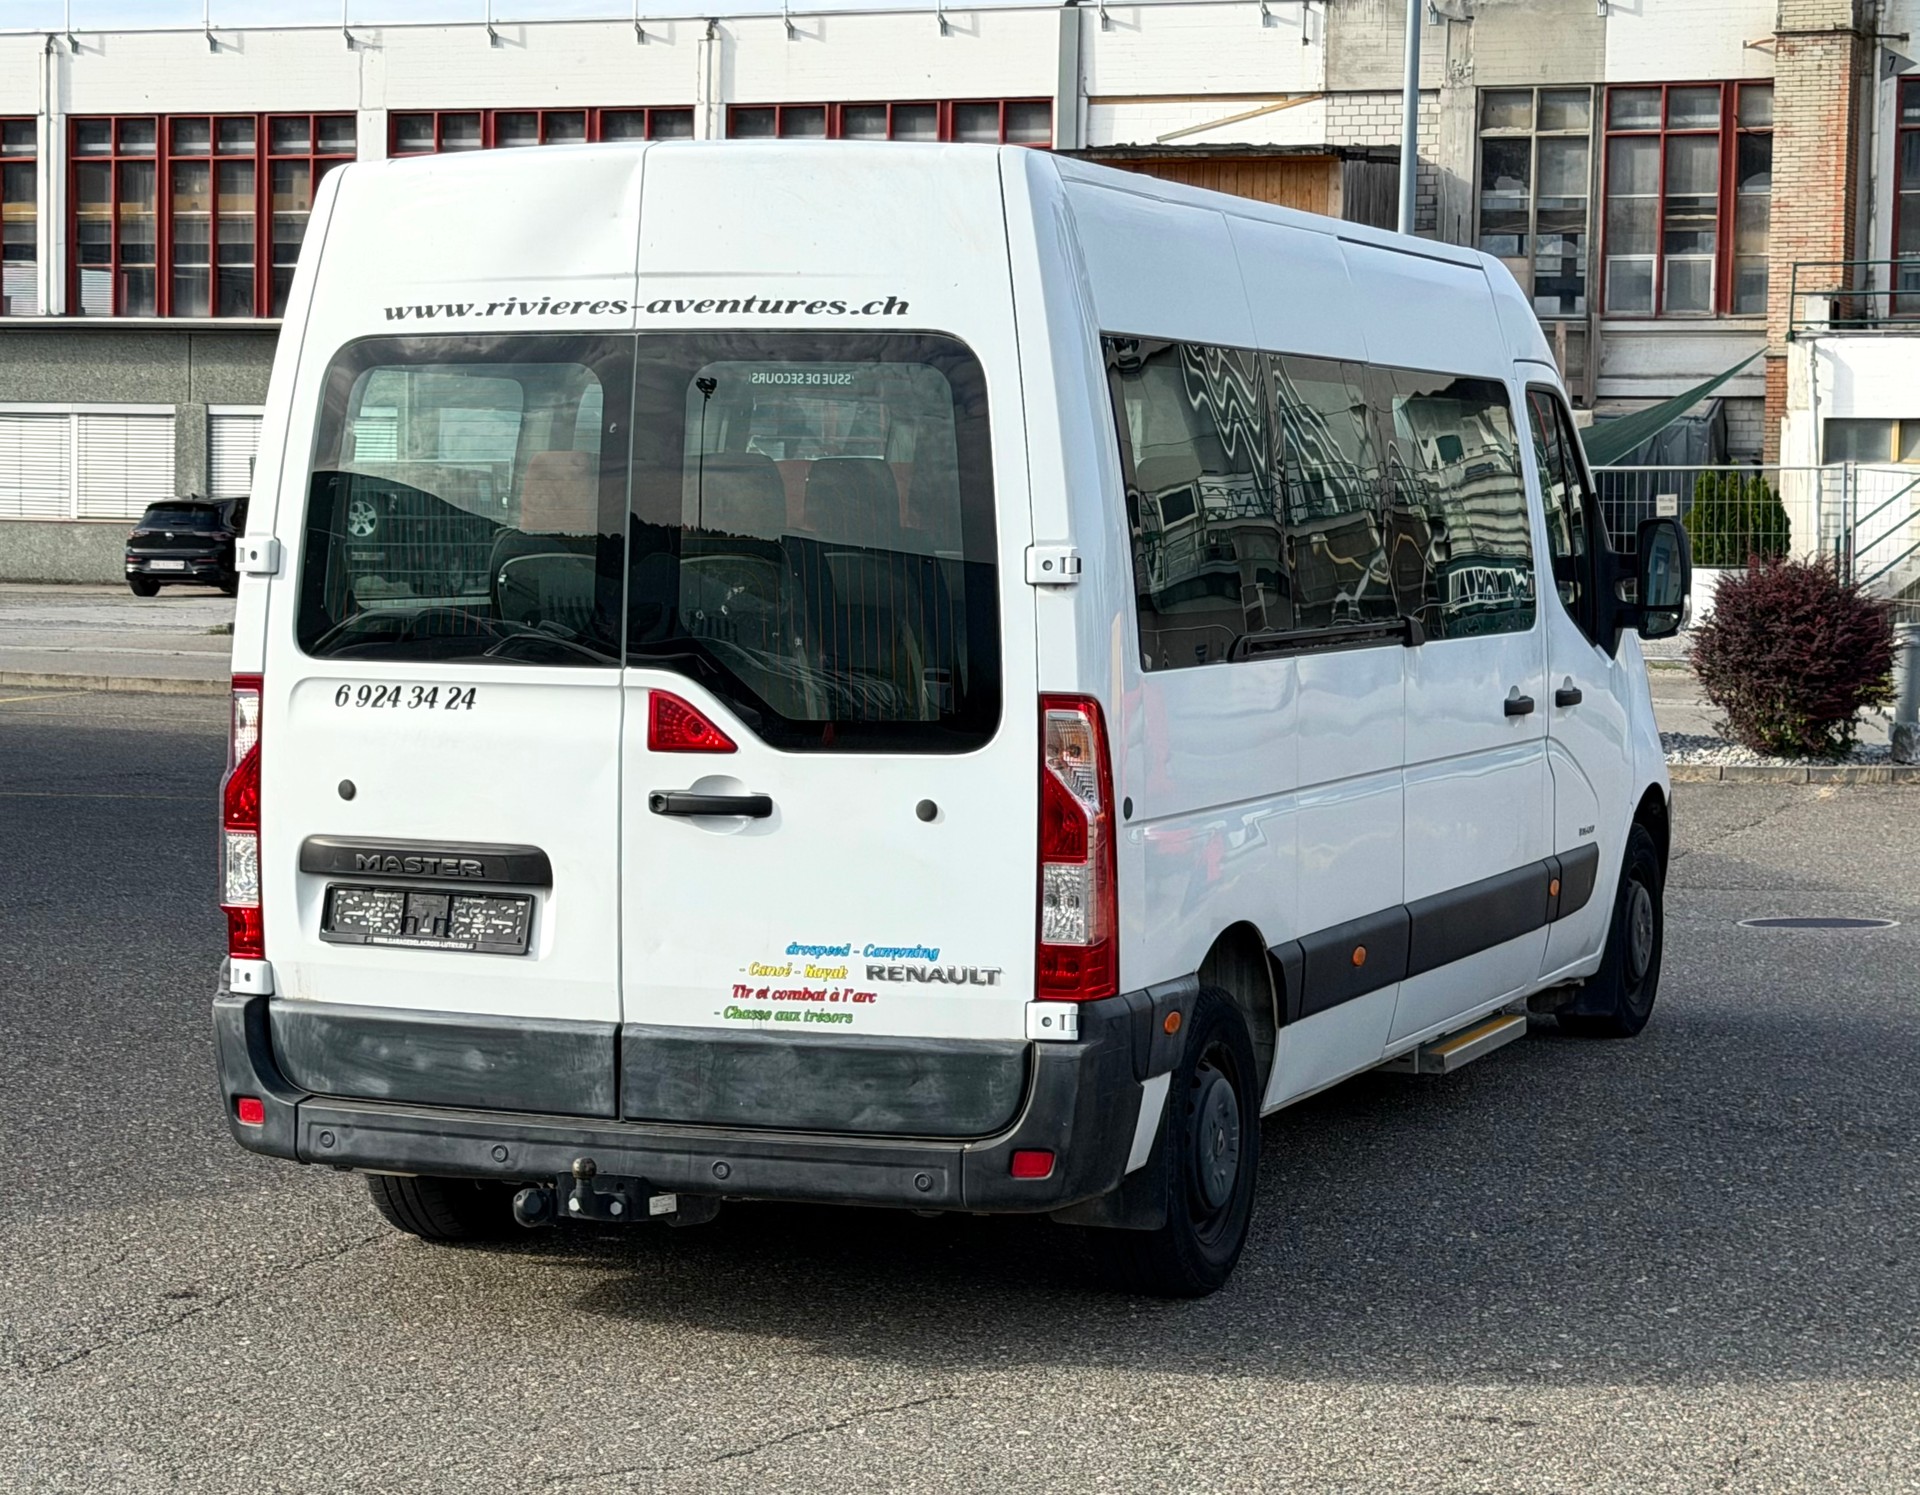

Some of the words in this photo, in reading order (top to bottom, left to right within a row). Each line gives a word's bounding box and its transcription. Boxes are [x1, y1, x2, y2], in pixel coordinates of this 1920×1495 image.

[1889, 56, 1896, 72] 7
[384, 295, 910, 321] www.rivieres-aventures.ch
[335, 684, 351, 707] 6
[355, 684, 402, 708] 924
[407, 685, 439, 709] 34
[444, 686, 477, 710] 24
[355, 853, 485, 878] MASTER
[863, 943, 941, 962] Canyoning
[804, 963, 848, 982] Kayak
[866, 964, 1002, 985] RENAULT
[732, 984, 754, 999] Tir
[756, 985, 770, 1000] et
[772, 987, 827, 1001] combat
[829, 987, 840, 1002] à
[842, 988, 878, 1003] l'arc
[723, 1005, 772, 1020] Chasse
[774, 1010, 802, 1021] aux
[803, 1008, 853, 1023] trésors
